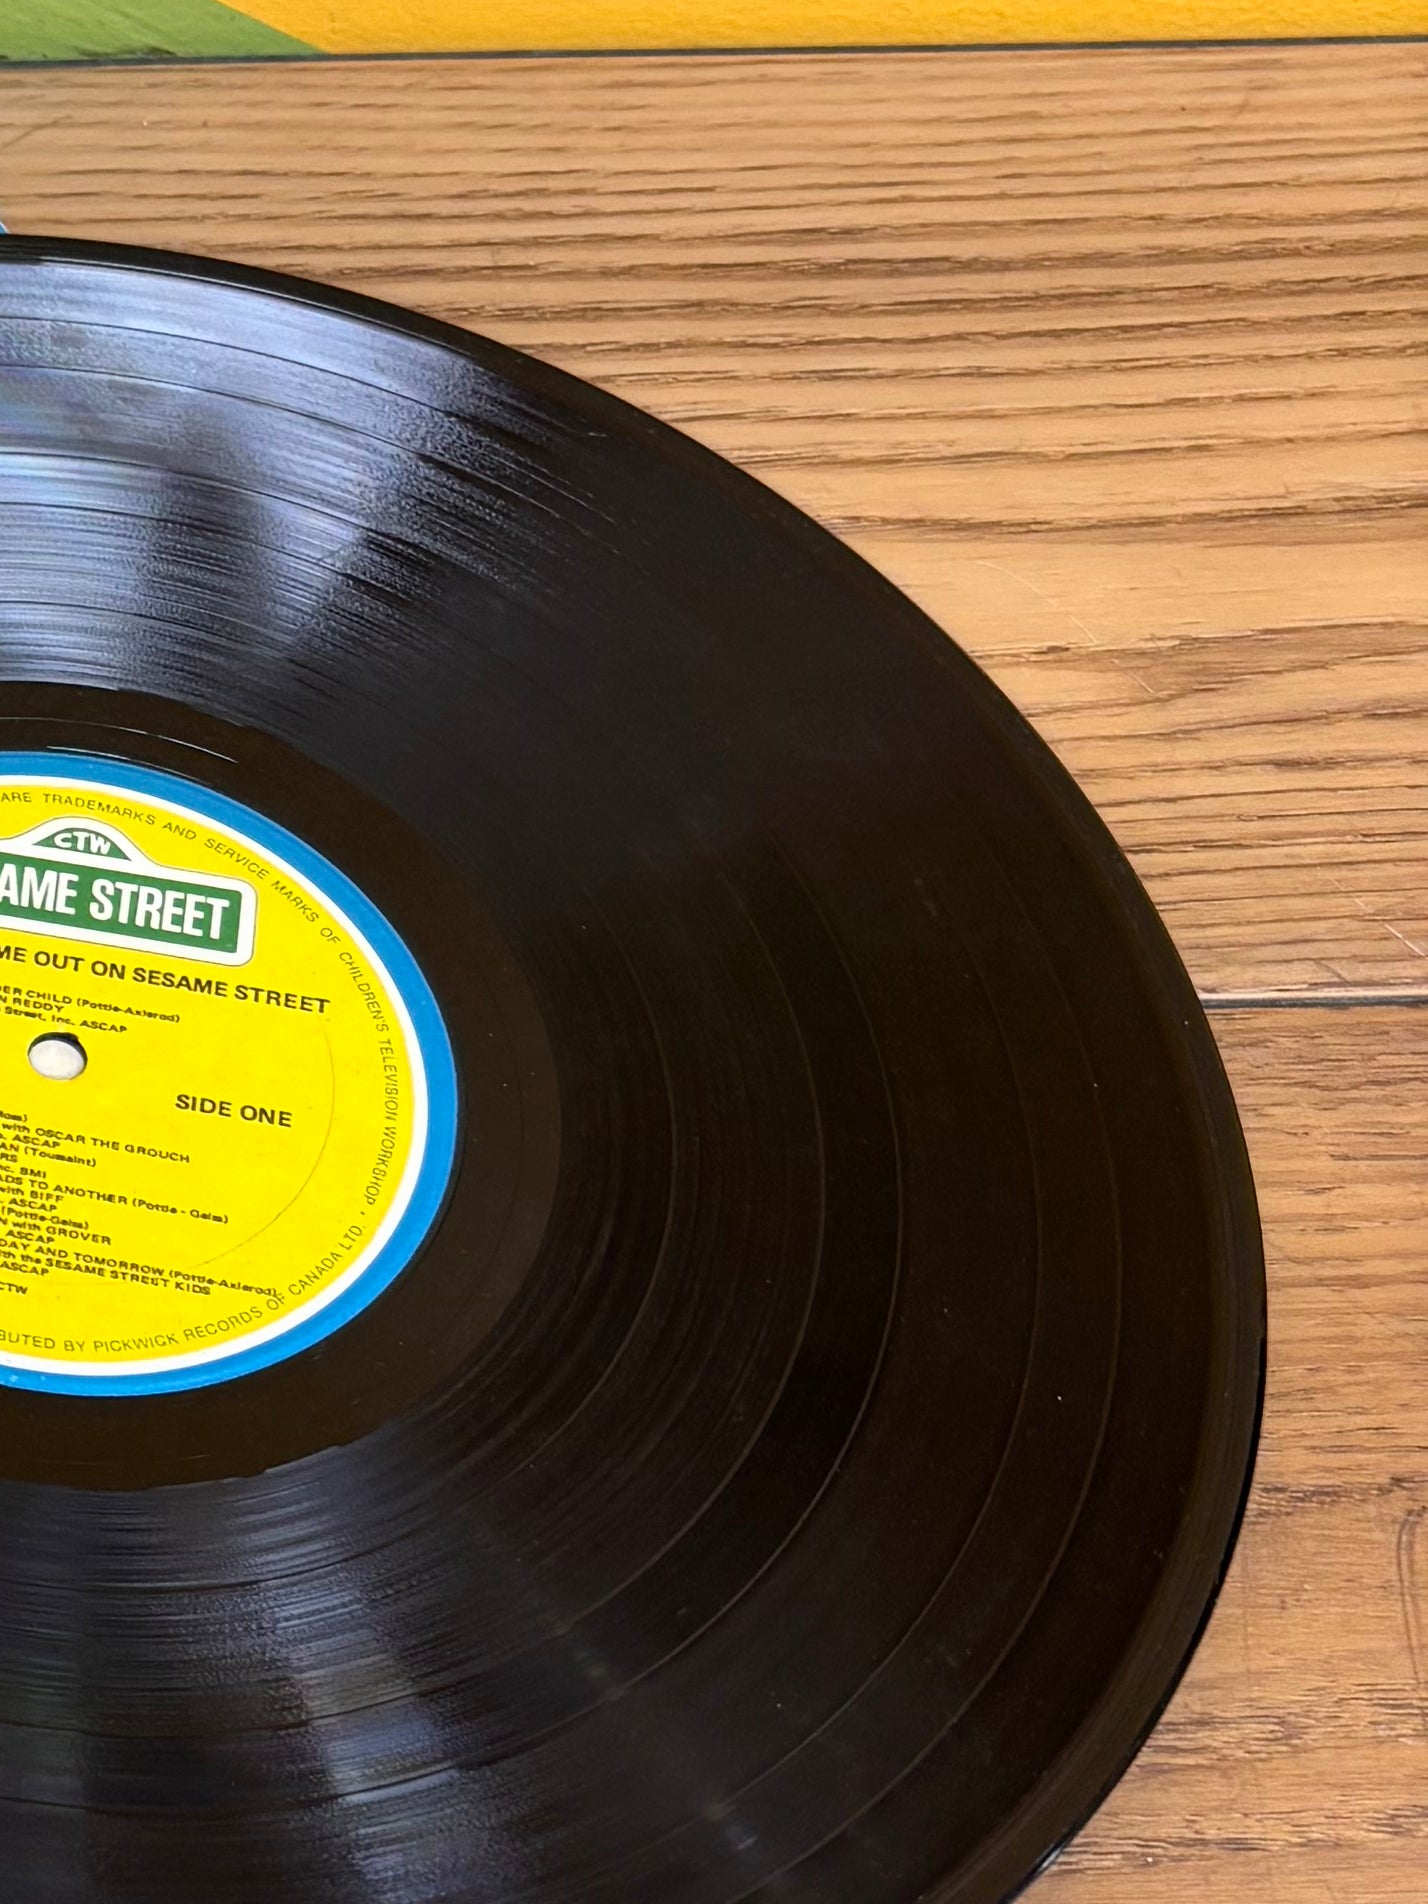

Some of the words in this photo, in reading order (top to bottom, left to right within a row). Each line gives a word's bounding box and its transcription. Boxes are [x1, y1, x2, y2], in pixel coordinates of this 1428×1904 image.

[1, 792, 32, 802] ARE
[44, 794, 156, 826] TRADEMARKS
[54, 831, 111, 855] CTW
[163, 821, 197, 841] AND
[204, 838, 270, 880] SERVICE
[89, 878, 230, 940] STREET
[271, 880, 320, 922] MARKS
[320, 927, 341, 945] OF
[26, 990, 72, 1004] CHILD
[34, 951, 85, 972] OUT
[91, 960, 126, 980] ON
[132, 967, 228, 997] SESAME
[234, 985, 331, 1013] STREET
[339, 951, 389, 1032] CHILDREN'S
[13, 997, 64, 1013] REDDY
[379, 1038, 399, 1121] TELEVISION
[175, 1094, 232, 1117] SIDE
[241, 1105, 292, 1127] ONE
[2, 1123, 30, 1133] with
[36, 1128, 86, 1144] OSCAR
[91, 1137, 119, 1150] THE
[124, 1144, 190, 1163] GROUCH
[364, 1126, 397, 1205] WORKSHOP
[29, 1179, 48, 1190] TO
[53, 1185, 128, 1205] ANOTHER
[64, 1341, 86, 1352] BY
[94, 1332, 179, 1353] PICKWICK
[184, 1306, 263, 1341] RECORDS
[288, 1252, 343, 1296] CANADA
